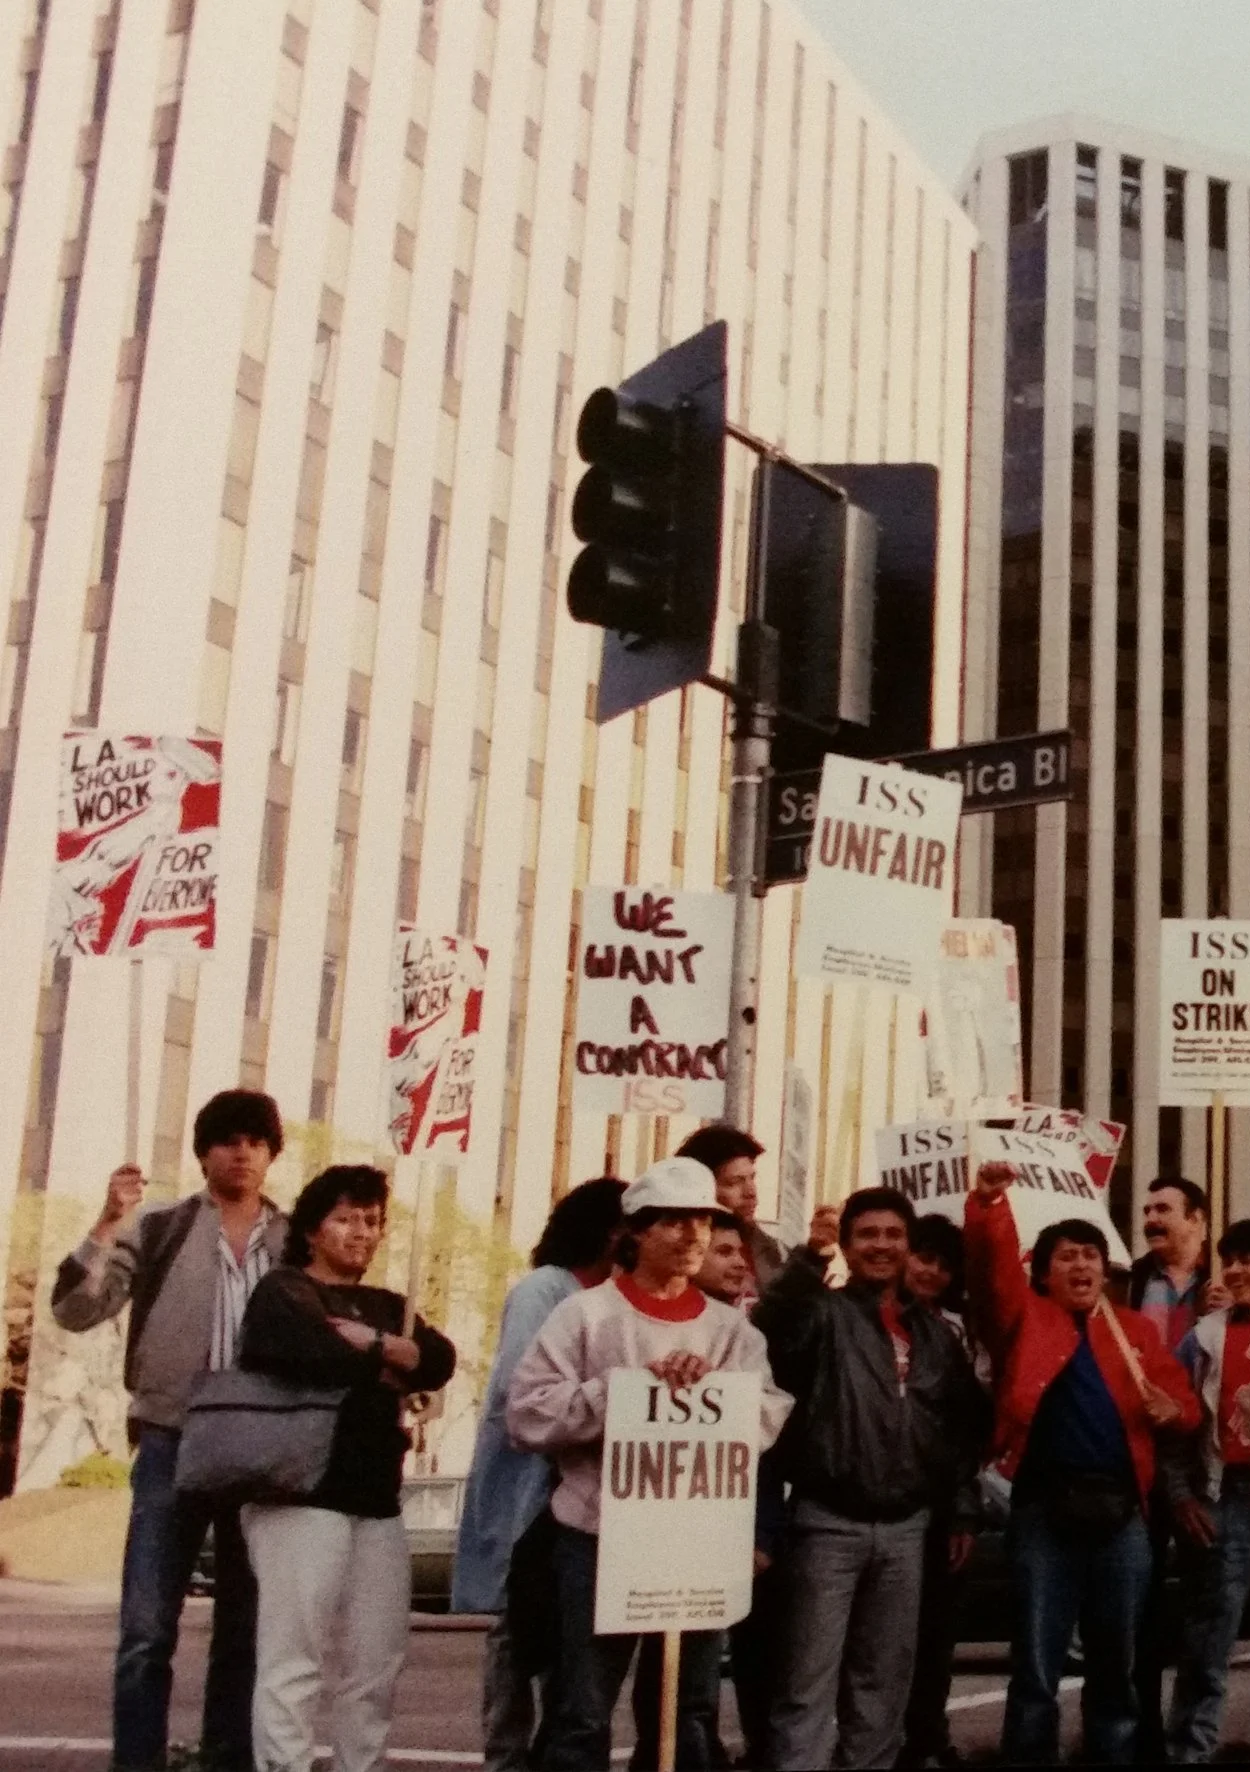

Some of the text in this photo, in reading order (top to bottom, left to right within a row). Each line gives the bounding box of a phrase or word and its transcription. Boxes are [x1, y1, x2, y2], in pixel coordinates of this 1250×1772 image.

[73, 759, 156, 793] SHOULD
[74, 781, 152, 828] WORK
[857, 775, 927, 818] ISS
[156, 843, 212, 874] FOR
[820, 816, 946, 890] UNFAIR
[613, 891, 687, 938] WE
[585, 944, 704, 984] WANT
[1190, 931, 1249, 960] ISS
[1202, 968, 1235, 997] ON
[403, 984, 451, 1025] WORK
[630, 995, 660, 1034] A
[623, 1080, 686, 1113] ISS
[900, 1126, 952, 1156] ISS
[1000, 1136, 1056, 1157] ISS
[1017, 1162, 1096, 1200] NFAIR
[647, 1386, 723, 1424] ISS
[610, 1440, 750, 1499] UNFAIR
